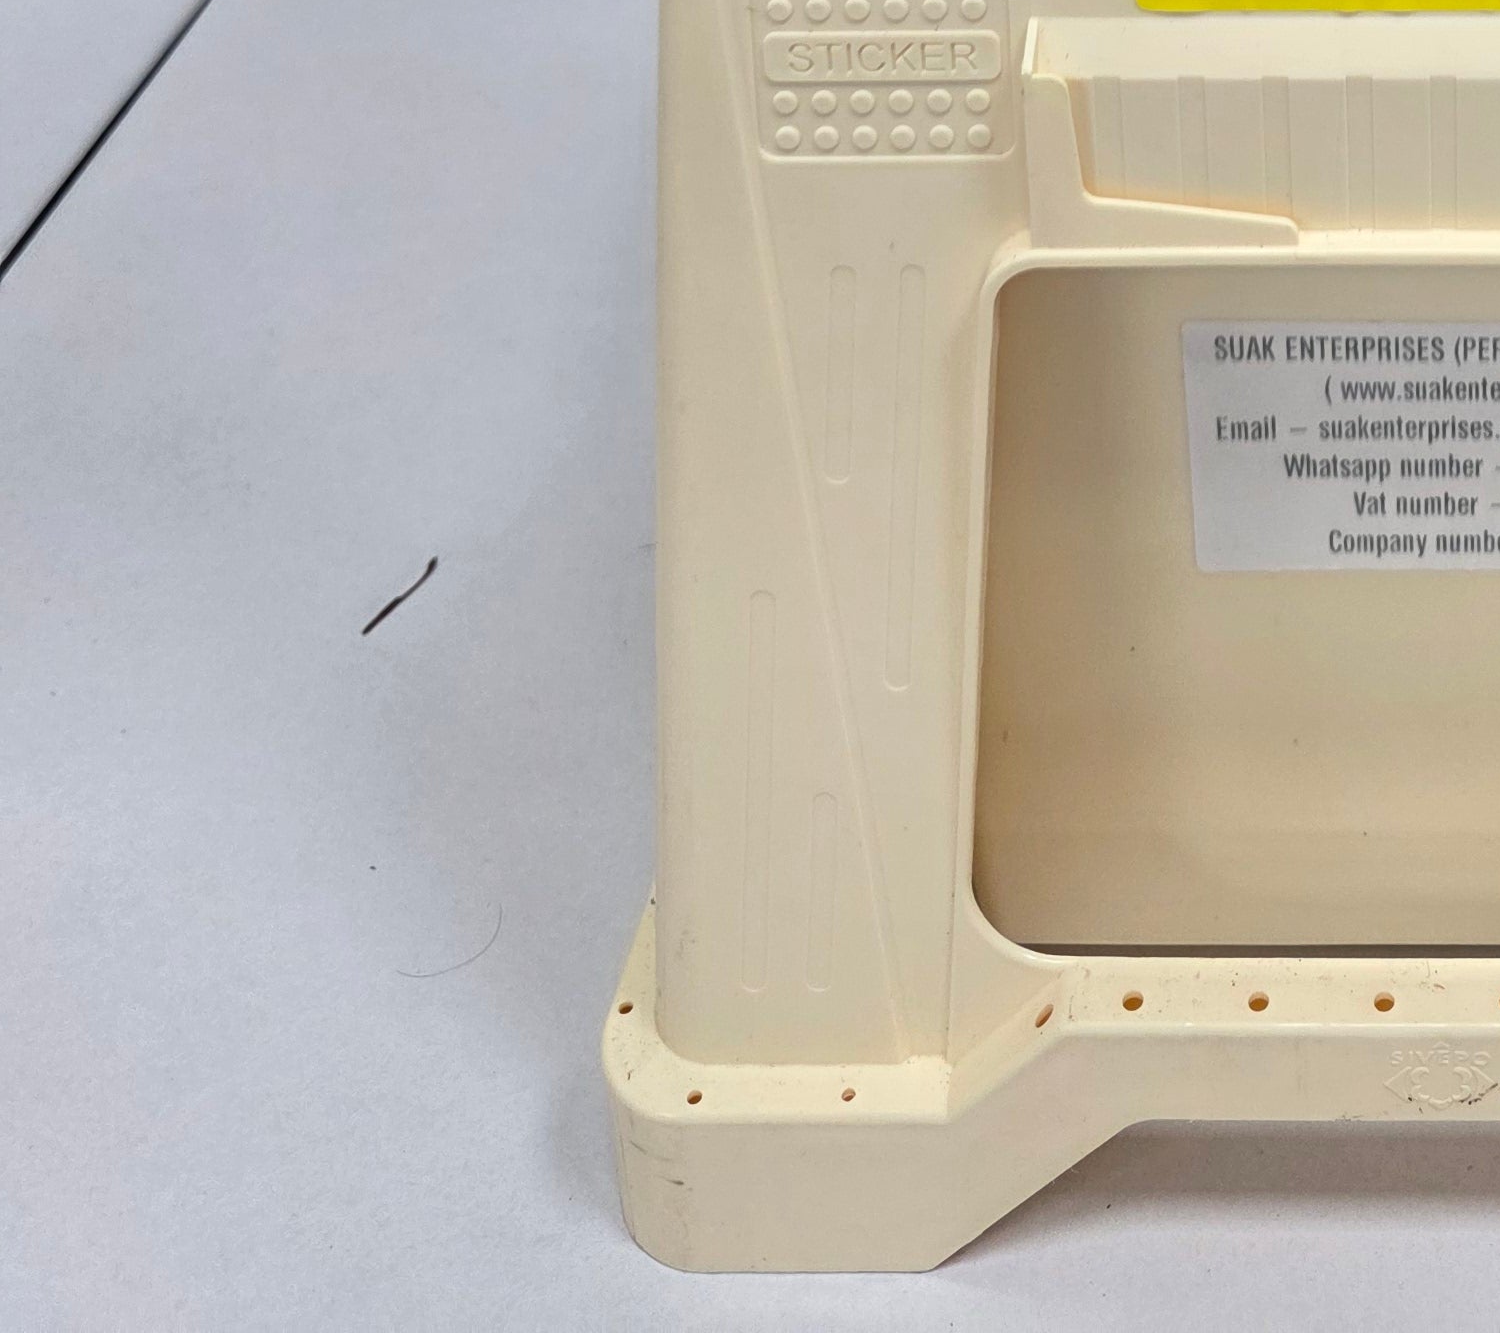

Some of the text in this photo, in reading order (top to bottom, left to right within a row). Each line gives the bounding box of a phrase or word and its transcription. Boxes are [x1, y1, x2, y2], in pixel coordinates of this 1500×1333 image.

[788, 42, 979, 74] STICKER
[1214, 335, 1275, 361] SUAK
[1286, 336, 1445, 362] ENTERPRISES
[1216, 415, 1277, 441] Email
[1283, 453, 1391, 483] Whatsapp
[1400, 453, 1484, 478] number
[1353, 491, 1387, 516] Vat
[1396, 491, 1479, 516] number
[1328, 530, 1427, 558] Company
